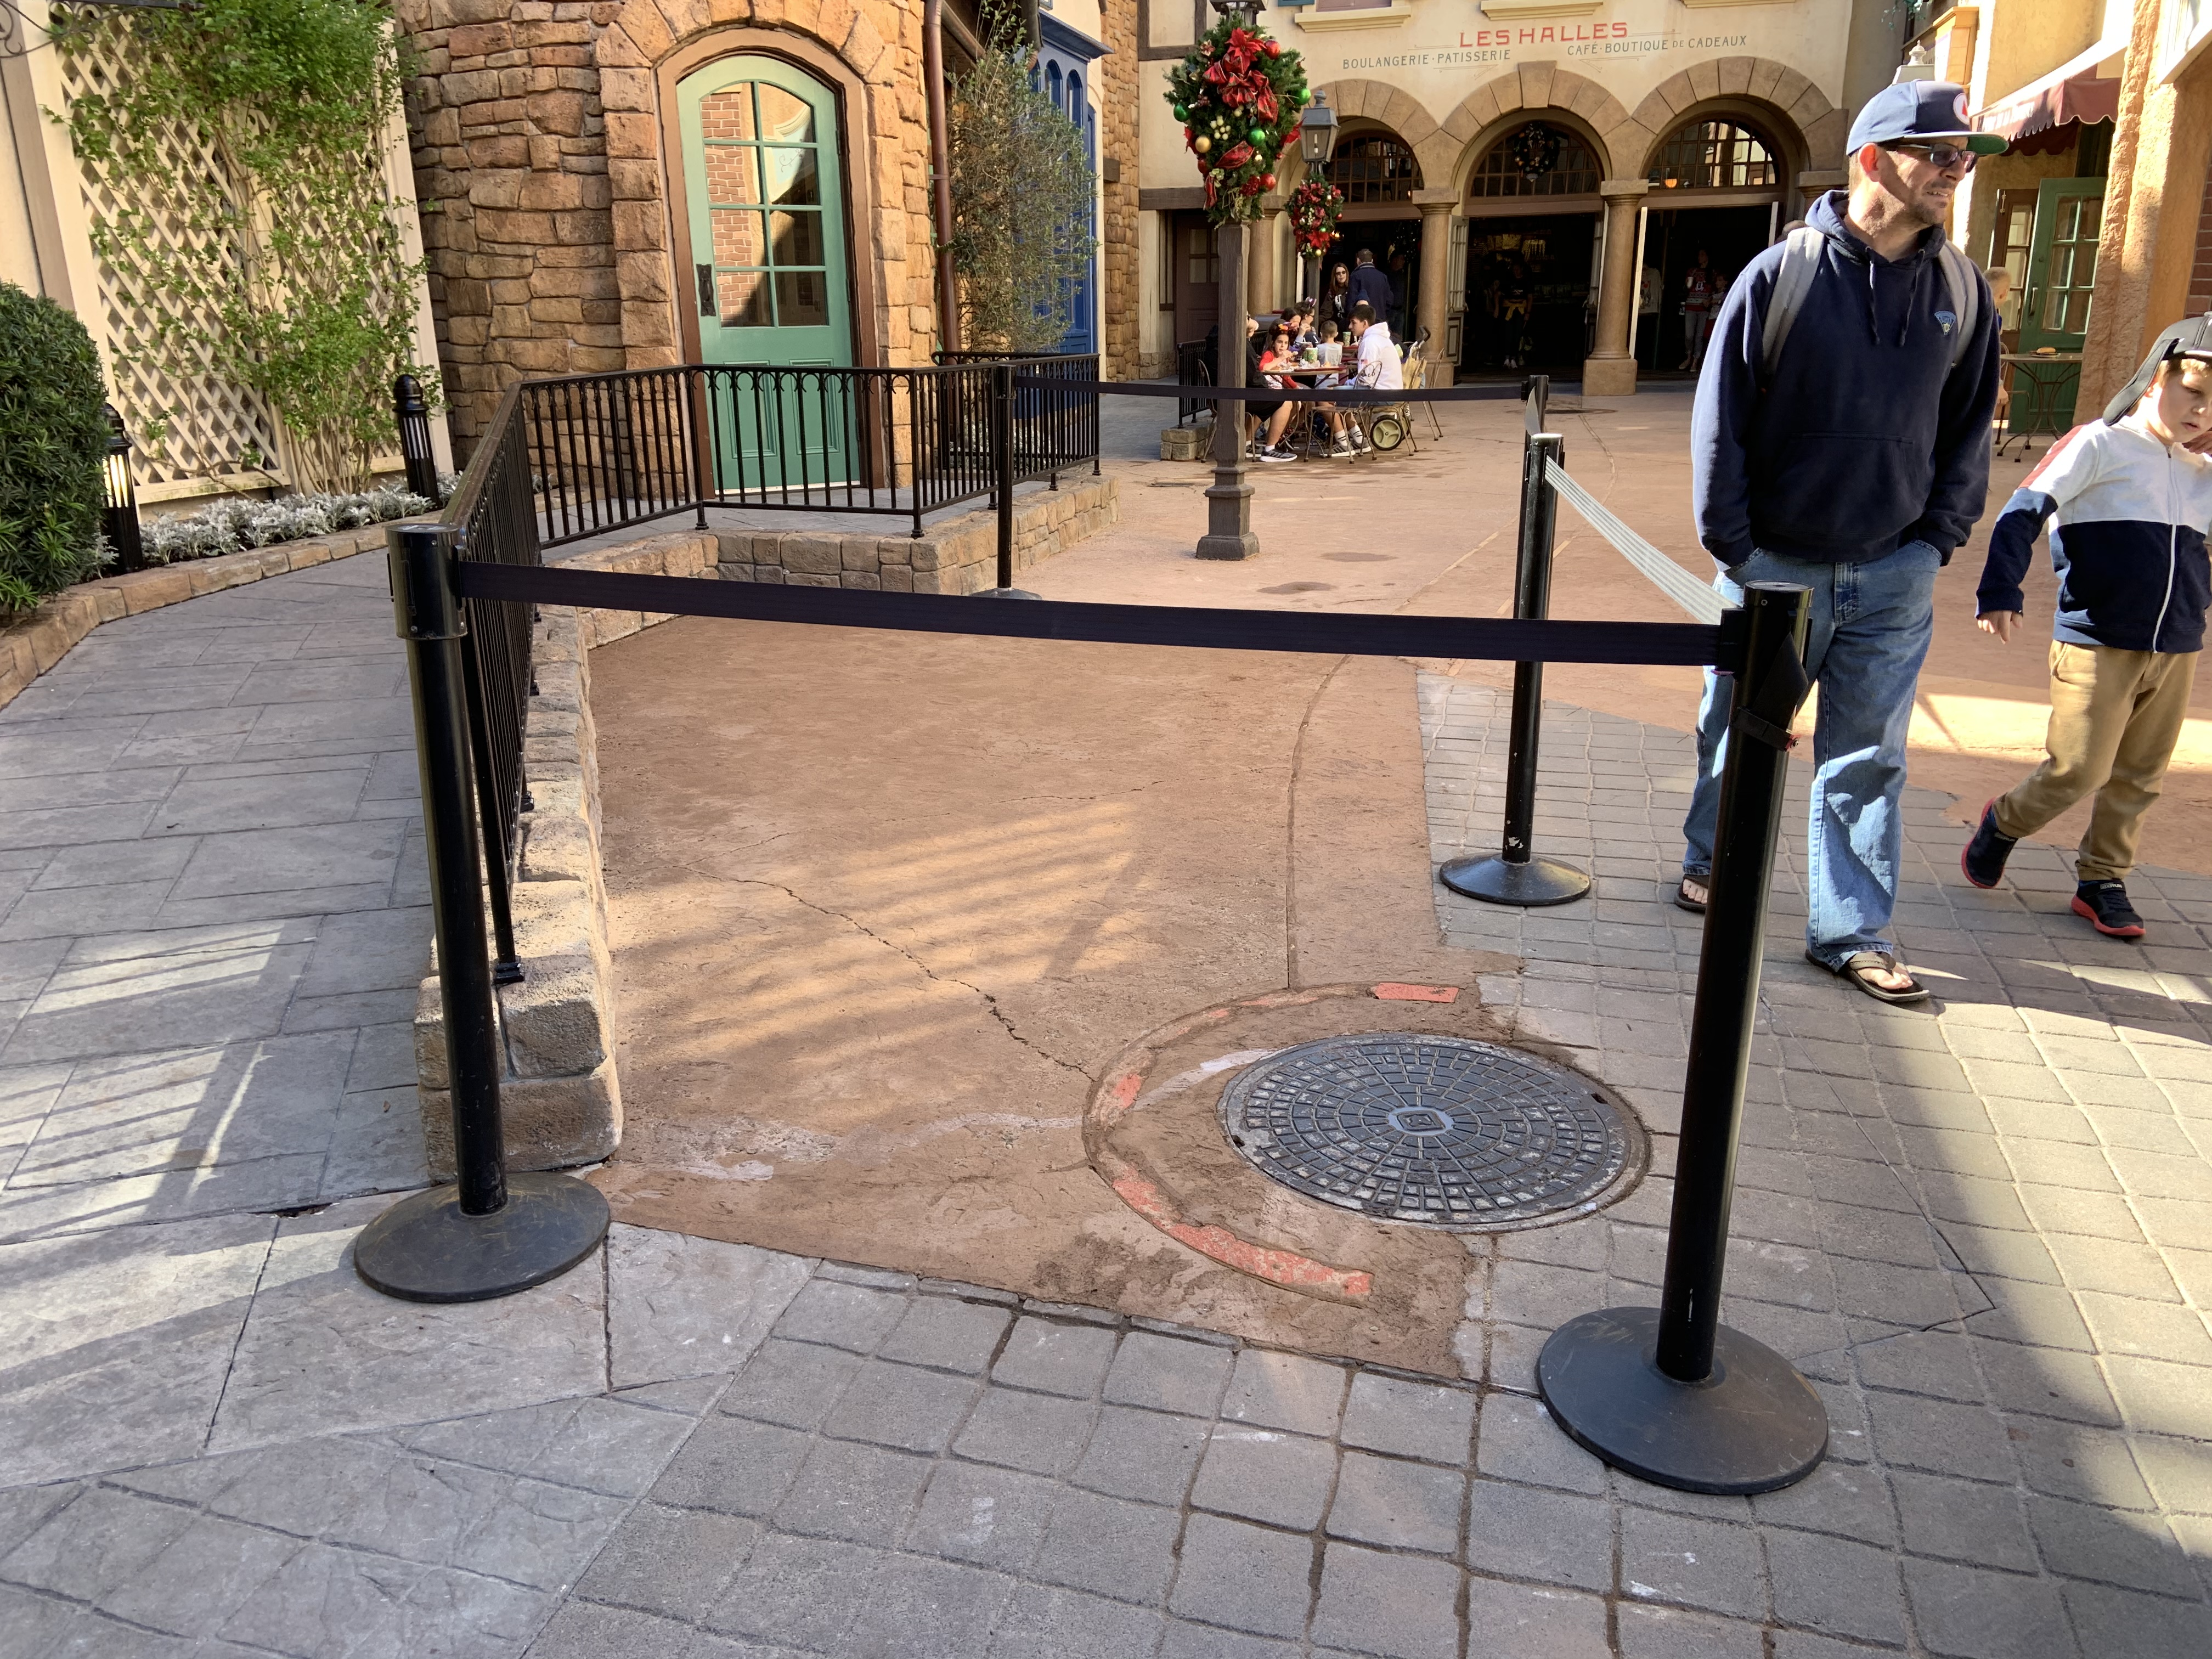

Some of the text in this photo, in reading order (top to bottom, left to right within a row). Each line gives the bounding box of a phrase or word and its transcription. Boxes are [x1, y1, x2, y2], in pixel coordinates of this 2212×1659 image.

[1459, 22, 1627, 48] LES HALLES
[1567, 42, 1598, 55] CAFÉ
[1605, 40, 1668, 53] BOUTIQUE
[1688, 36, 1746, 48] CADEAUX
[1342, 49, 1511, 69] BOULANGERIE PATISSERIE
